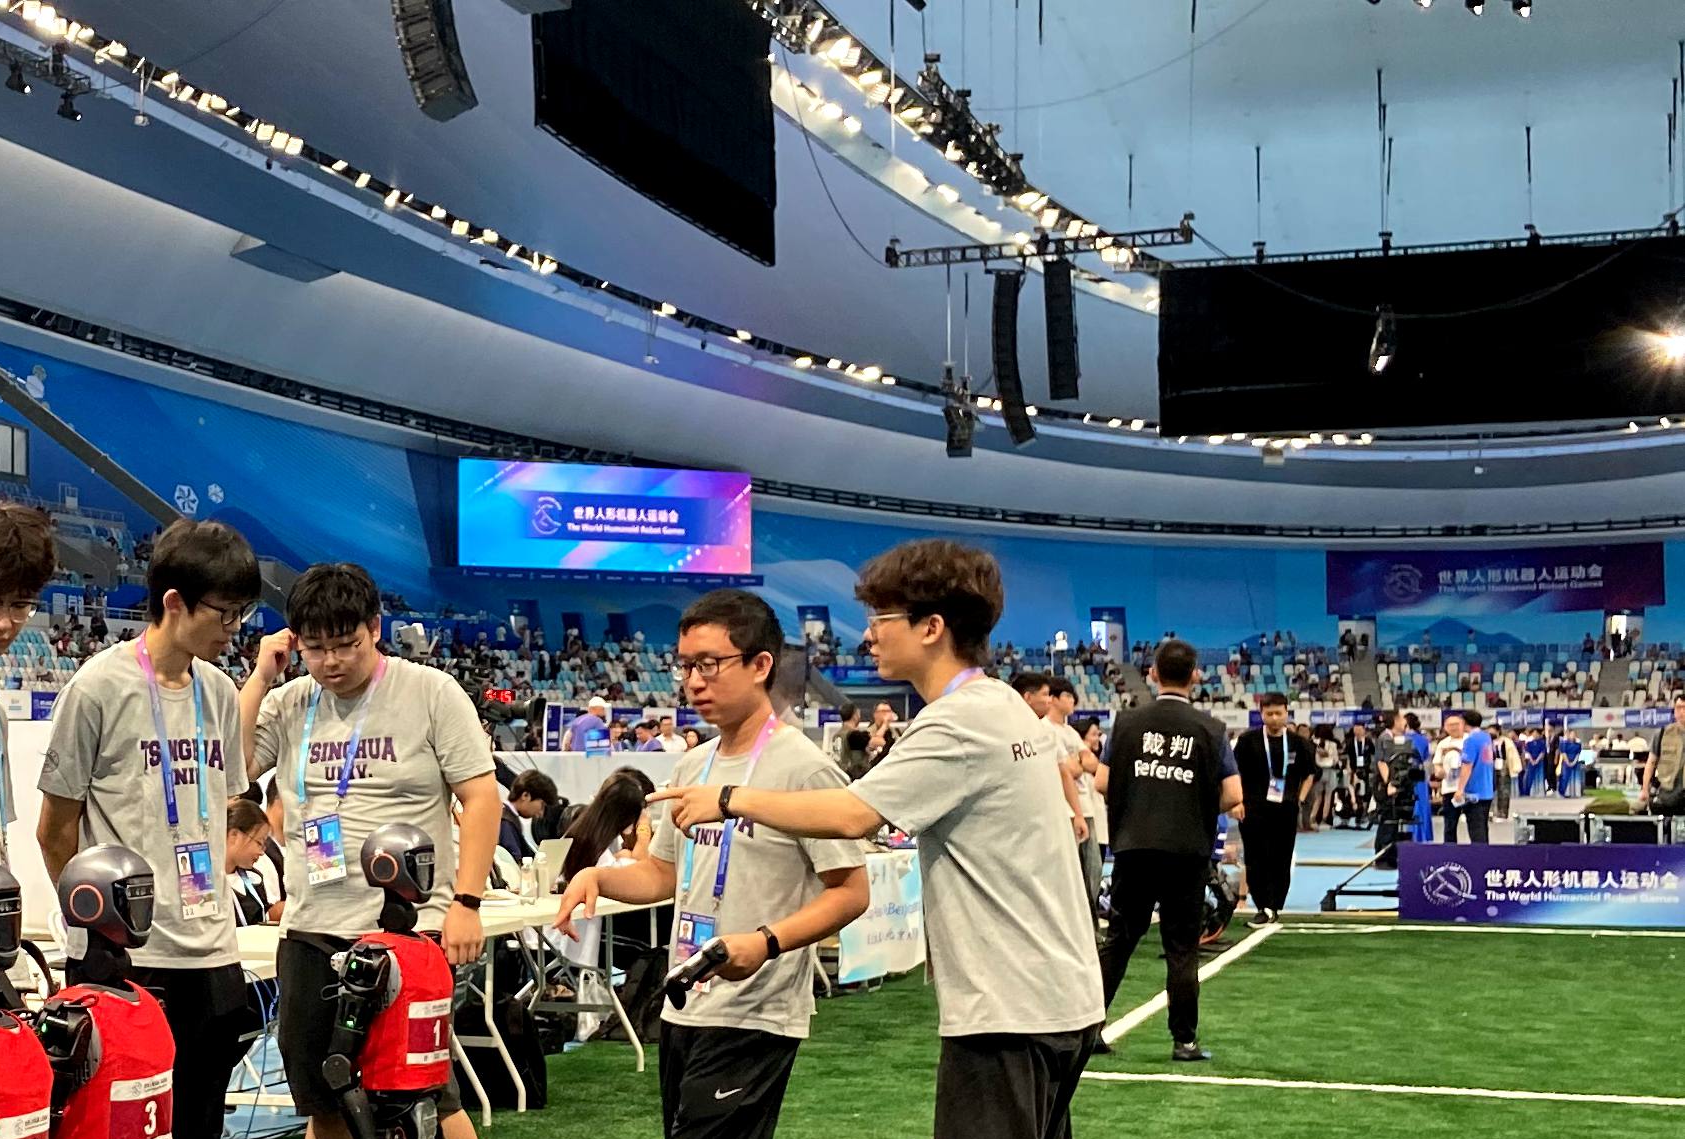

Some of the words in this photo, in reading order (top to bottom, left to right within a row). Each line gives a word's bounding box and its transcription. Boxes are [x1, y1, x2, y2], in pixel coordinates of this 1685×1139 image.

[1438, 564, 1603, 583] 世界人形机器人运动会
[141, 738, 224, 771] TSNGA
[309, 737, 396, 764] SINHUA
[1142, 731, 1194, 760] 裁判
[1135, 760, 1194, 784] Referee
[1484, 869, 1680, 889] 世界人形机器人运动会
[1485, 890, 1506, 901] The
[1508, 890, 1542, 902] World
[433, 1019, 441, 1047] 1
[144, 1100, 158, 1135] 3
